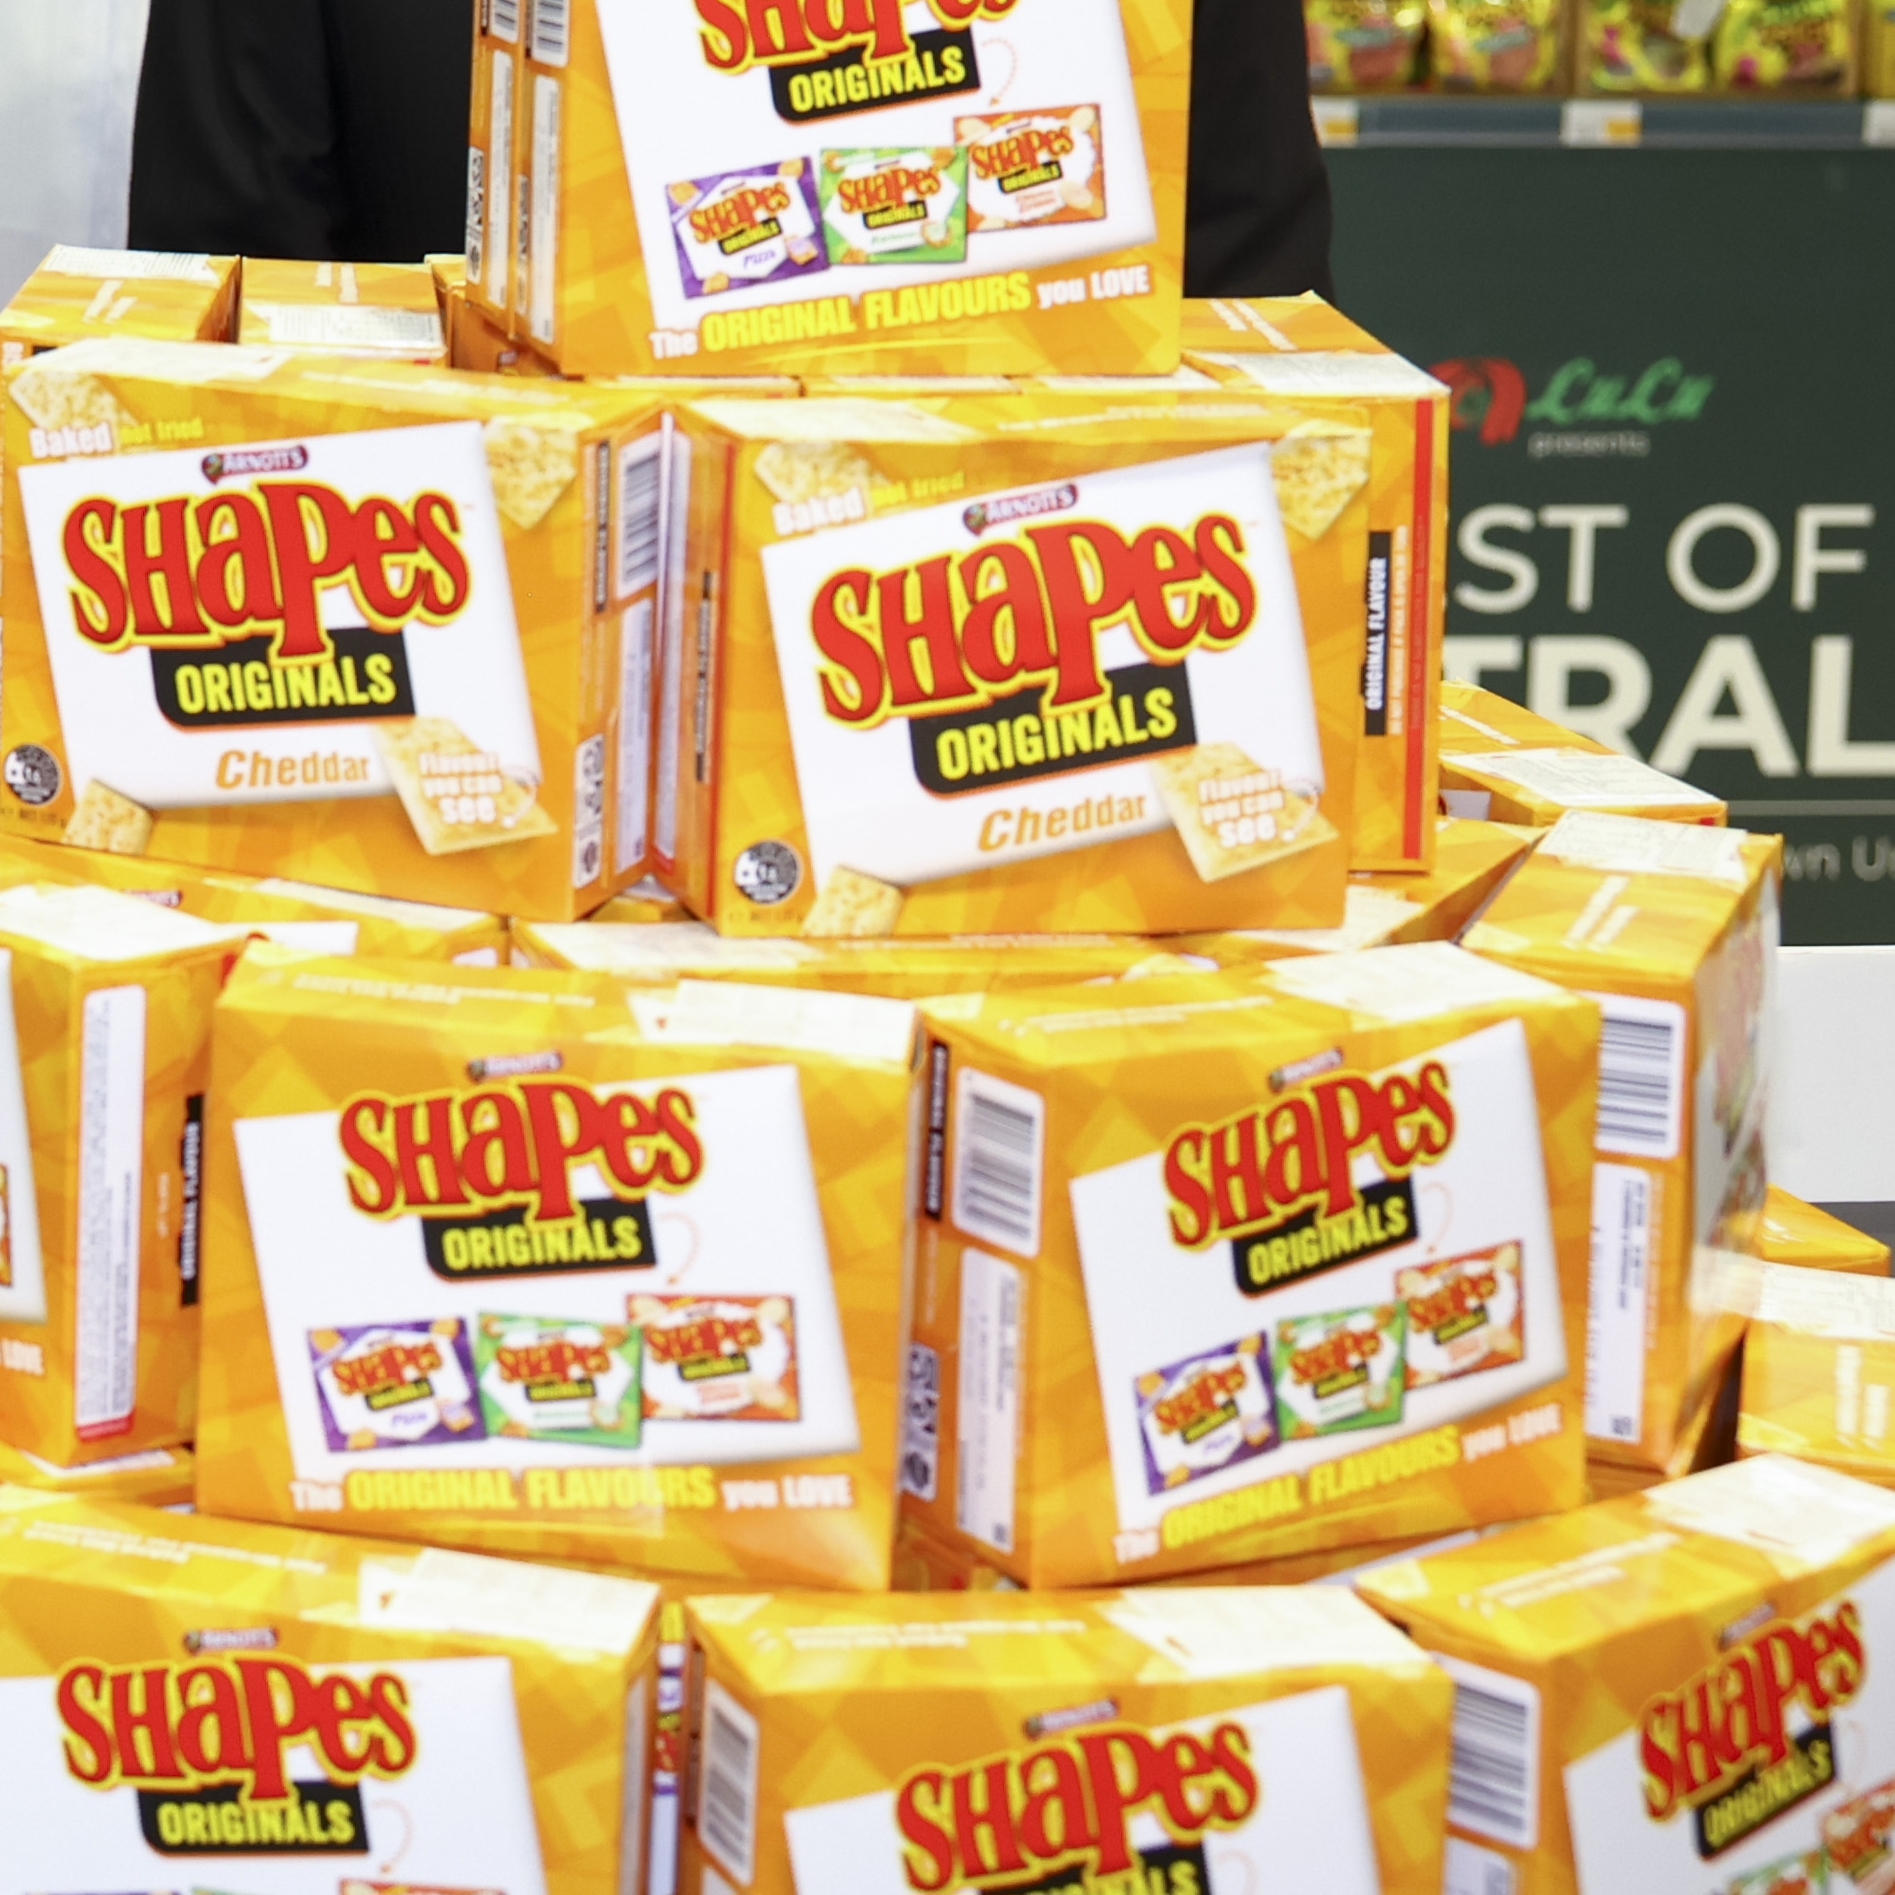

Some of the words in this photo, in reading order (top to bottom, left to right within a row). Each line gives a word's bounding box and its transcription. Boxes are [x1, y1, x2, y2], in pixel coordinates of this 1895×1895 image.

[787, 44, 968, 115] ORIGINALS
[647, 327, 700, 360] The
[702, 295, 857, 354] ORIGINAL
[865, 271, 1031, 330] FLAVOURS
[1037, 278, 1088, 310] you
[1090, 264, 1151, 300] LOVE
[28, 420, 113, 460] Baked
[773, 484, 865, 536] Baked
[1665, 501, 1876, 614] OF
[1365, 555, 1388, 631] FLAVOUR
[171, 651, 399, 716] ORIGINALS
[1363, 632, 1385, 712] ORIGINAL
[213, 748, 371, 790] Cheddar
[934, 686, 1179, 784] ORIGINALS
[975, 793, 1148, 853] Cheddar
[440, 1215, 643, 1273] ORIGINALS
[1245, 1194, 1413, 1288] ORIGINALS
[292, 1481, 342, 1512] The
[346, 1468, 517, 1513] ORIGINAL
[525, 1465, 716, 1509] FLAVOURS
[782, 1472, 854, 1509] LOVE
[1162, 1473, 1305, 1552] ORIGINAL
[1309, 1426, 1463, 1506] FLAVOURS
[157, 1801, 356, 1846] ORIGINALS
